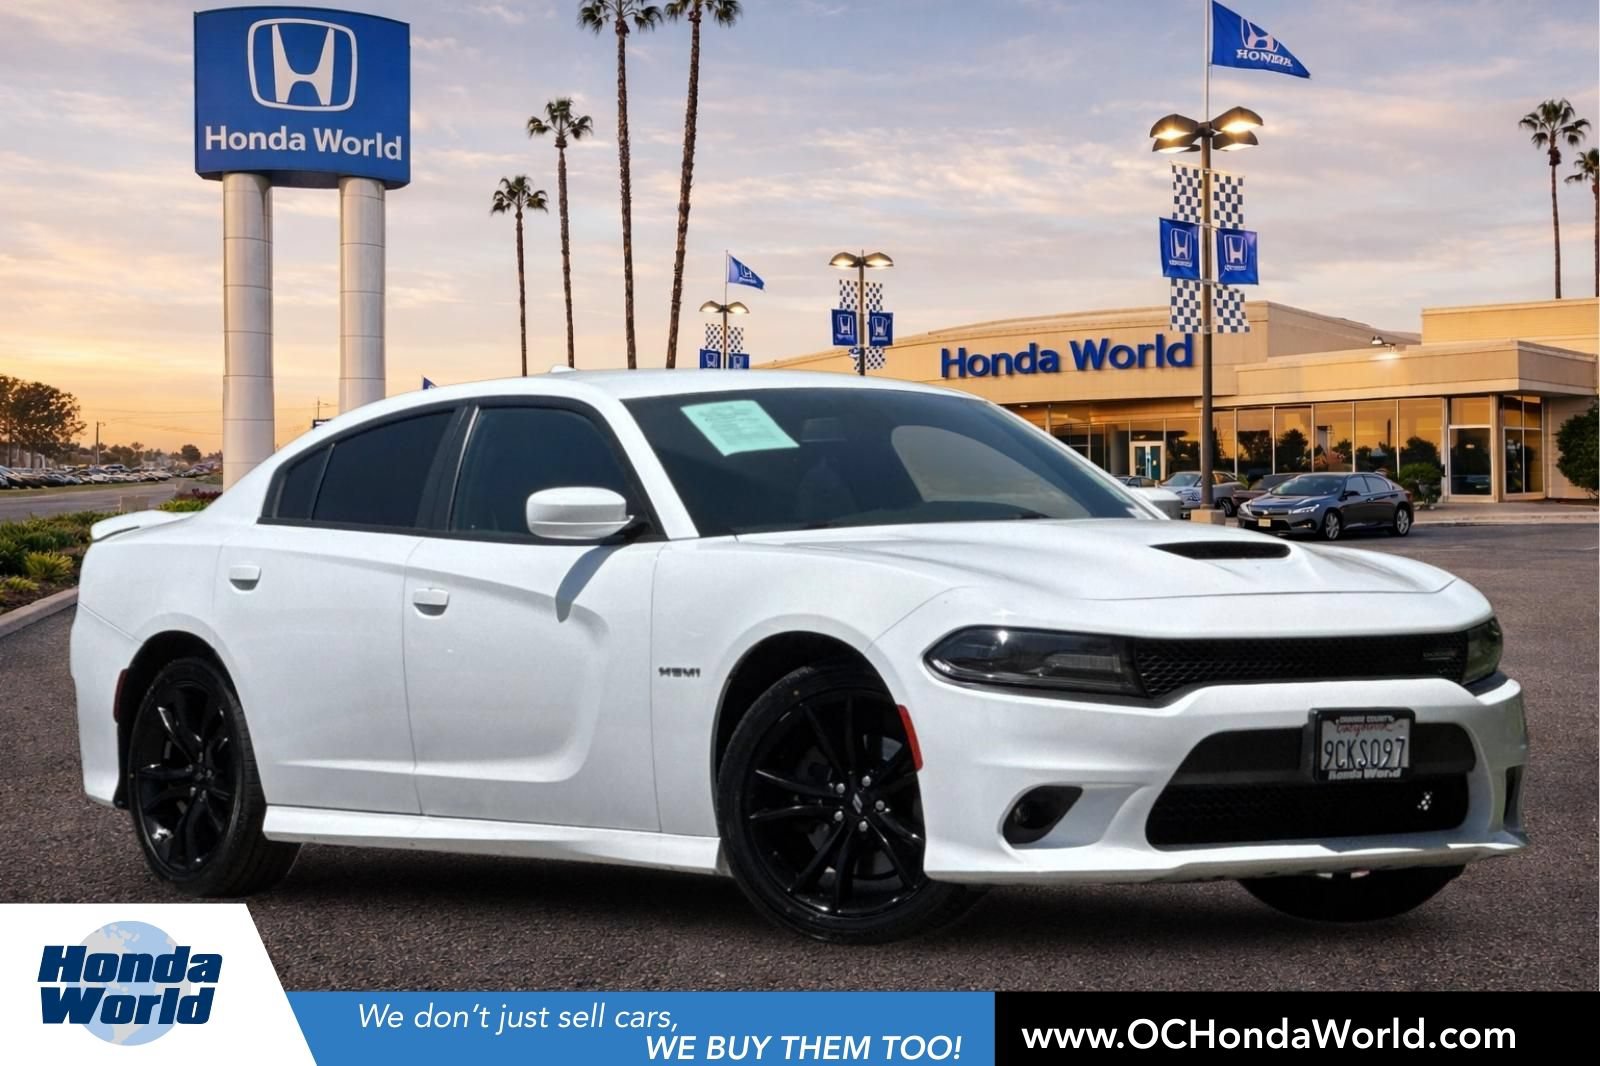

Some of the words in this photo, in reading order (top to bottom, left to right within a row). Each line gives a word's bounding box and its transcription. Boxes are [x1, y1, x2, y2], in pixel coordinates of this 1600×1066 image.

[205, 125, 306, 151] Honda
[313, 127, 402, 160] World
[941, 343, 1060, 378] Honda
[1070, 334, 1194, 370] World
[1324, 737, 1405, 769] 9CKS097
